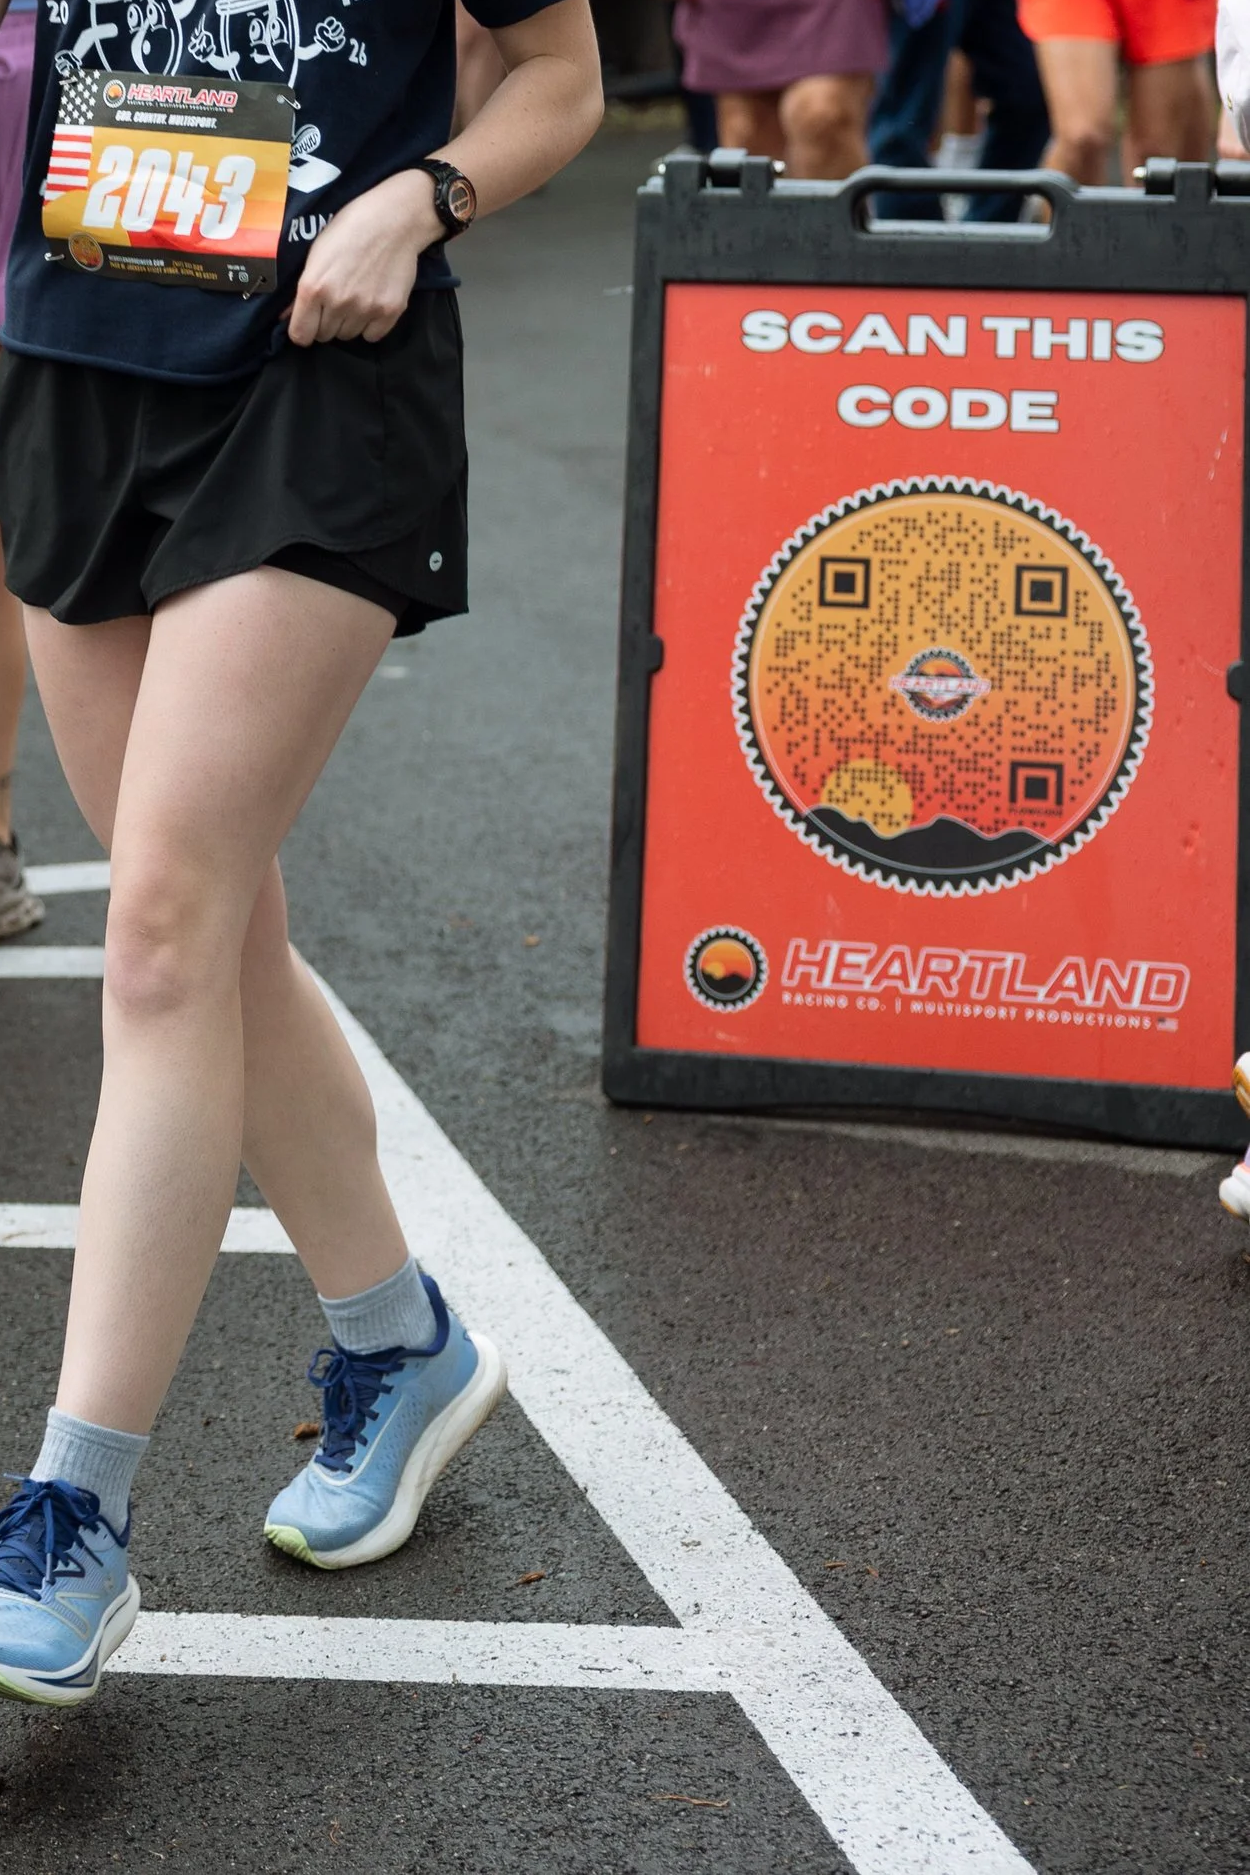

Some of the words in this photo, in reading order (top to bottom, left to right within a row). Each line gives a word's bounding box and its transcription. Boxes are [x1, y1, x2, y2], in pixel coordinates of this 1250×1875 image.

[46, 0, 69, 25] 20
[349, 38, 368, 66] 26
[127, 83, 238, 108] HEARTLAND
[82, 144, 256, 241] 2043
[740, 309, 968, 358] SCAN
[981, 316, 1165, 363] THIS
[836, 384, 1060, 434] CODE
[781, 937, 1191, 1013] HEARTLAND
[781, 991, 848, 1010] RACING
[855, 995, 887, 1012] CO.
[910, 1000, 1018, 1021] MULTISPORT
[1025, 1007, 1152, 1031] PRODUCTIONS
